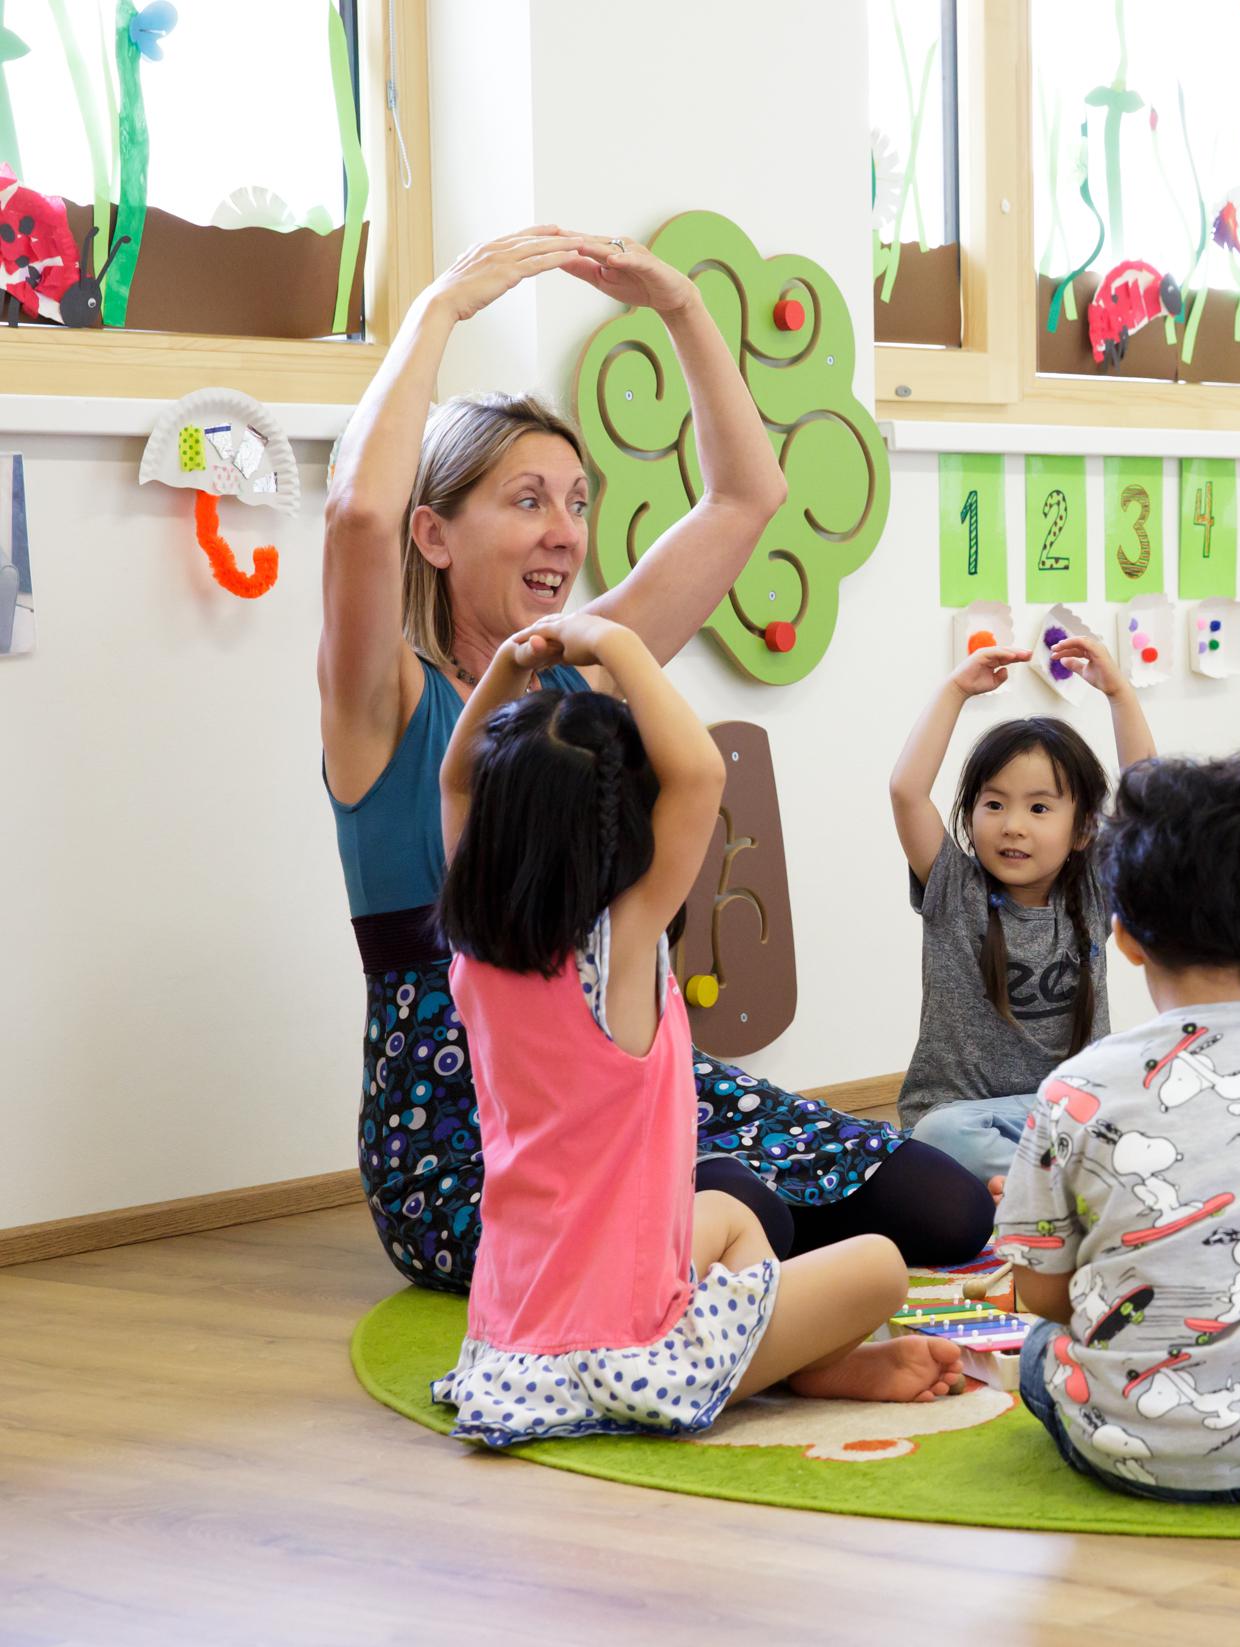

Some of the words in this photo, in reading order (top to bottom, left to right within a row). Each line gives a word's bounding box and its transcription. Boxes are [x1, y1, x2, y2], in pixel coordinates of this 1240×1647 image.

[960, 490, 978, 576] 1
[1038, 489, 1071, 571] 2
[1117, 484, 1151, 580] 3
[1193, 480, 1215, 559] 4
